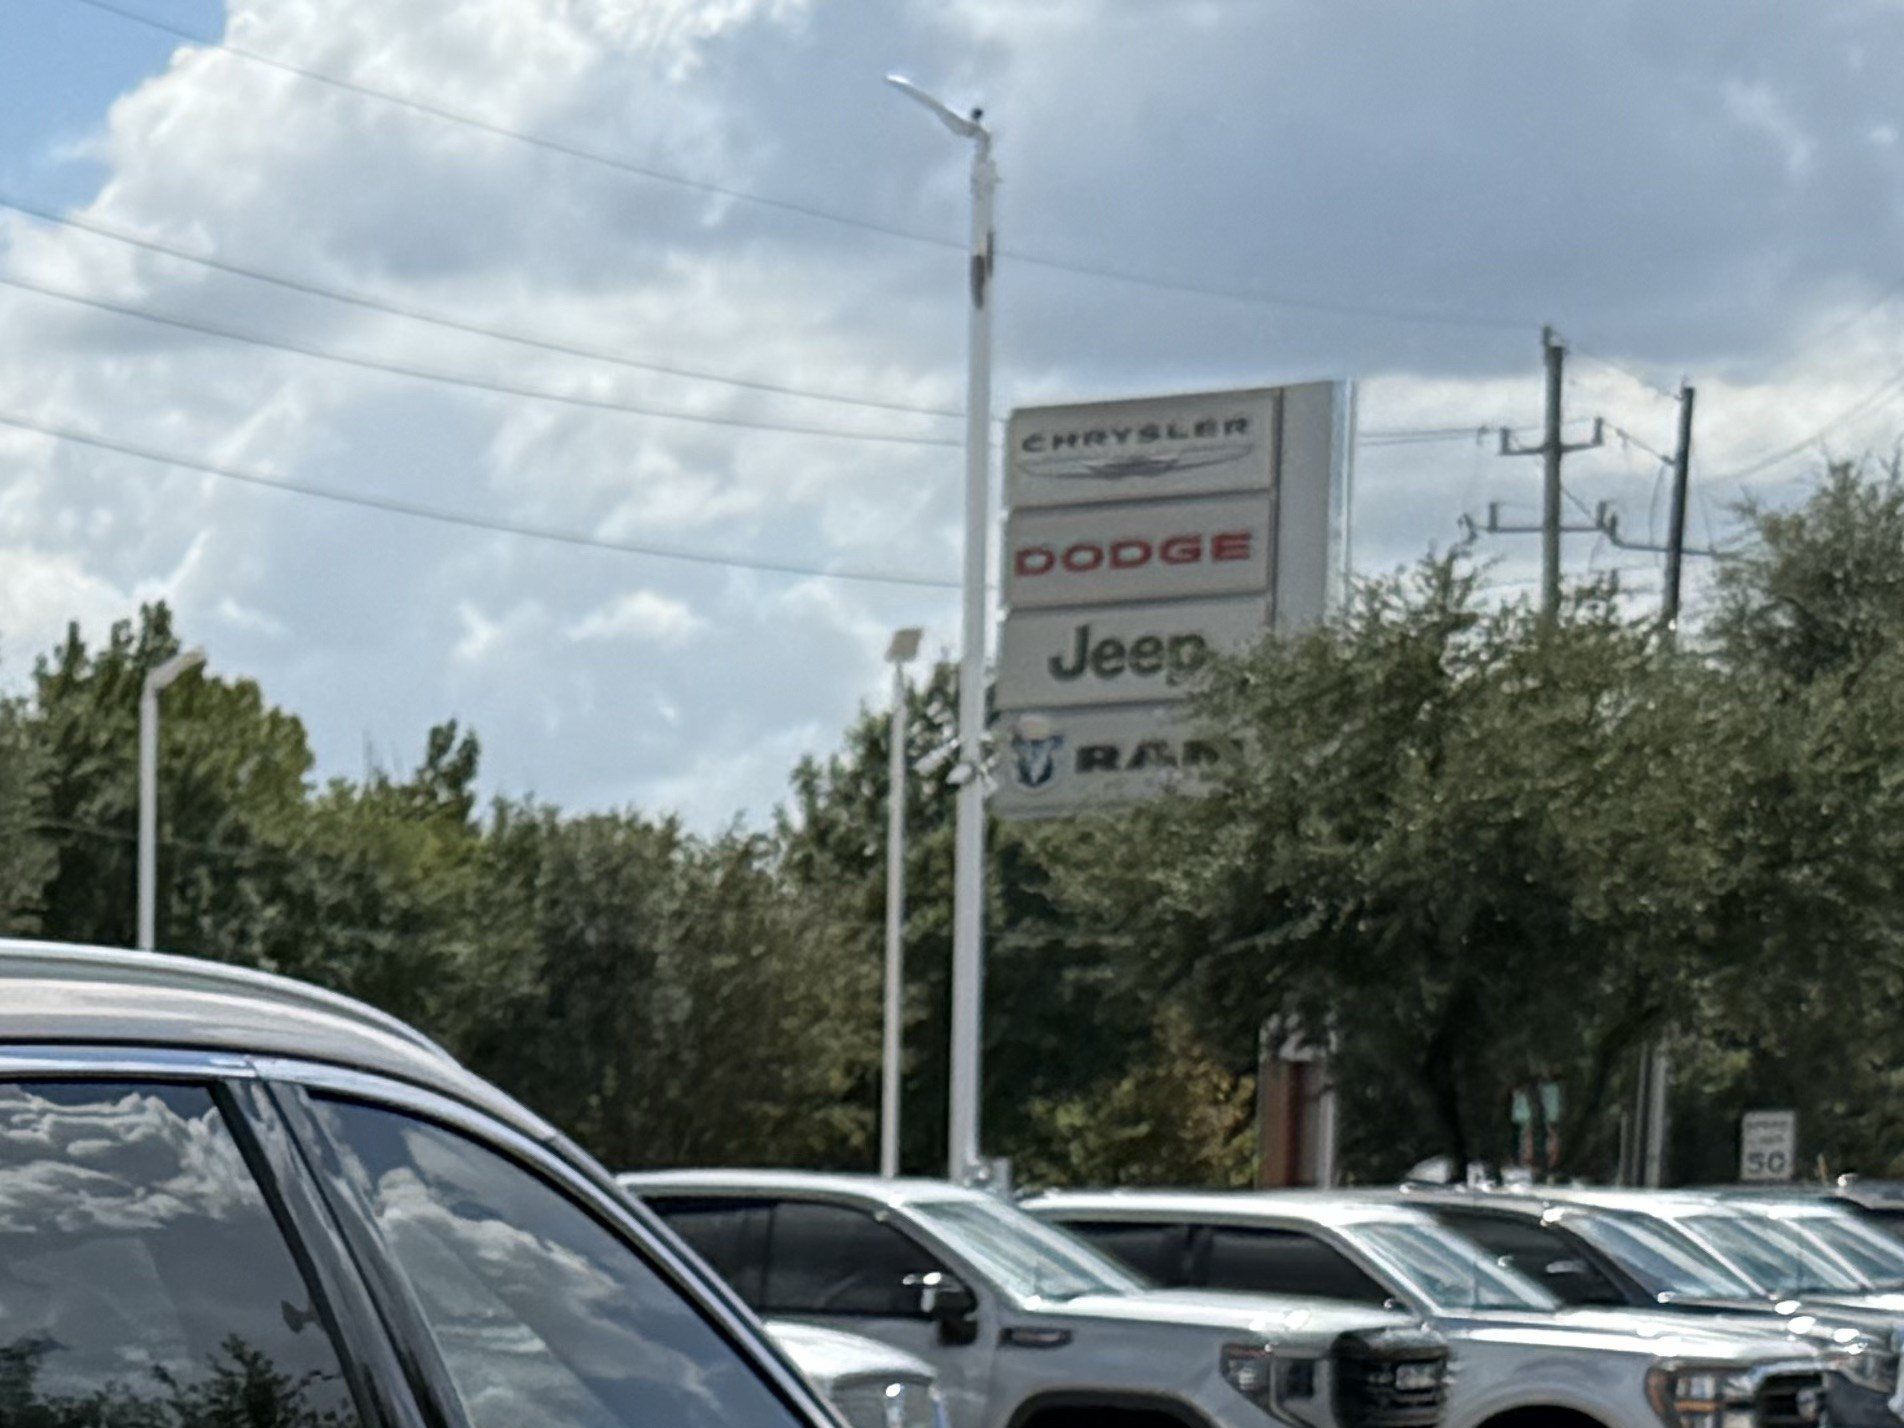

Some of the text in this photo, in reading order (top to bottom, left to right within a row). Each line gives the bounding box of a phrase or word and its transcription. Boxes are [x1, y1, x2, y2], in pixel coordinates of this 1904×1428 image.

[1021, 415, 1250, 454] CHRYSLER
[1014, 532, 1254, 577] DODGE
[1049, 624, 1209, 686] Jeep
[1748, 1151, 1786, 1173] 50
